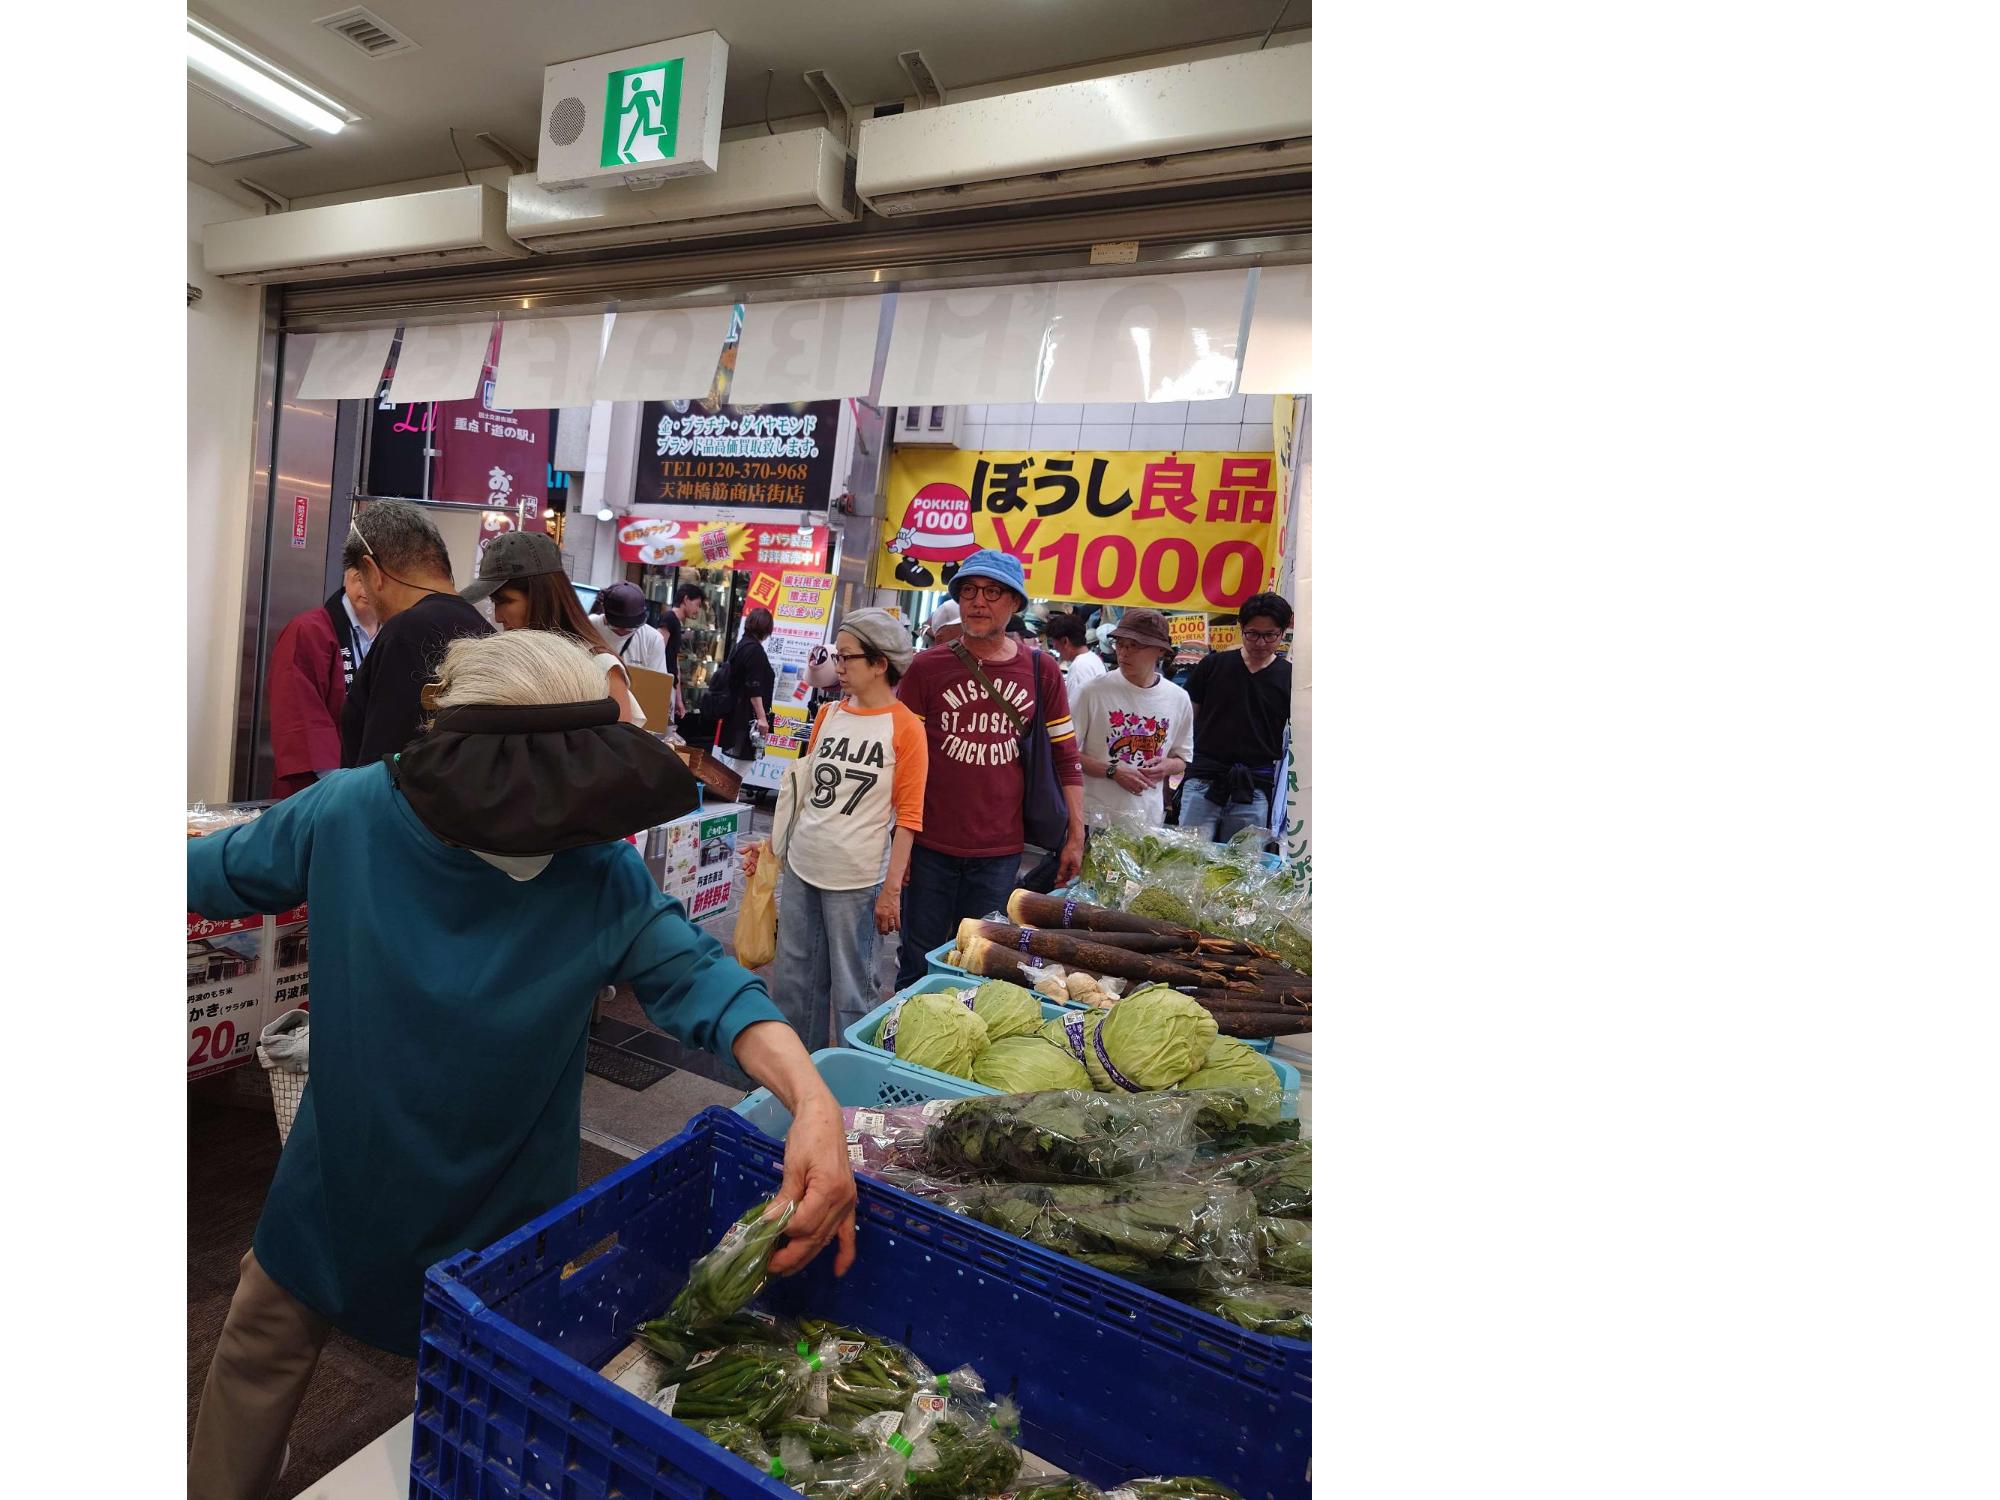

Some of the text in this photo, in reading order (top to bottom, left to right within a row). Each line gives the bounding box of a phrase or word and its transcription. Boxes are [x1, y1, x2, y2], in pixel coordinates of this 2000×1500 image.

[453, 417, 535, 444] 重点「道の駅」
[657, 436, 819, 458] ブランド品高価買取致します。
[659, 481, 805, 505] 天神橋筋商店街店
[913, 498, 969, 511] POKKIRI
[913, 511, 968, 530] 1000
[700, 528, 728, 547] 高価
[703, 545, 731, 563] 買取
[818, 737, 884, 768] BAJA
[941, 734, 1020, 766] TRACK CLUB
[810, 763, 878, 816] 87
[693, 880, 732, 914] 新鮮野菜
